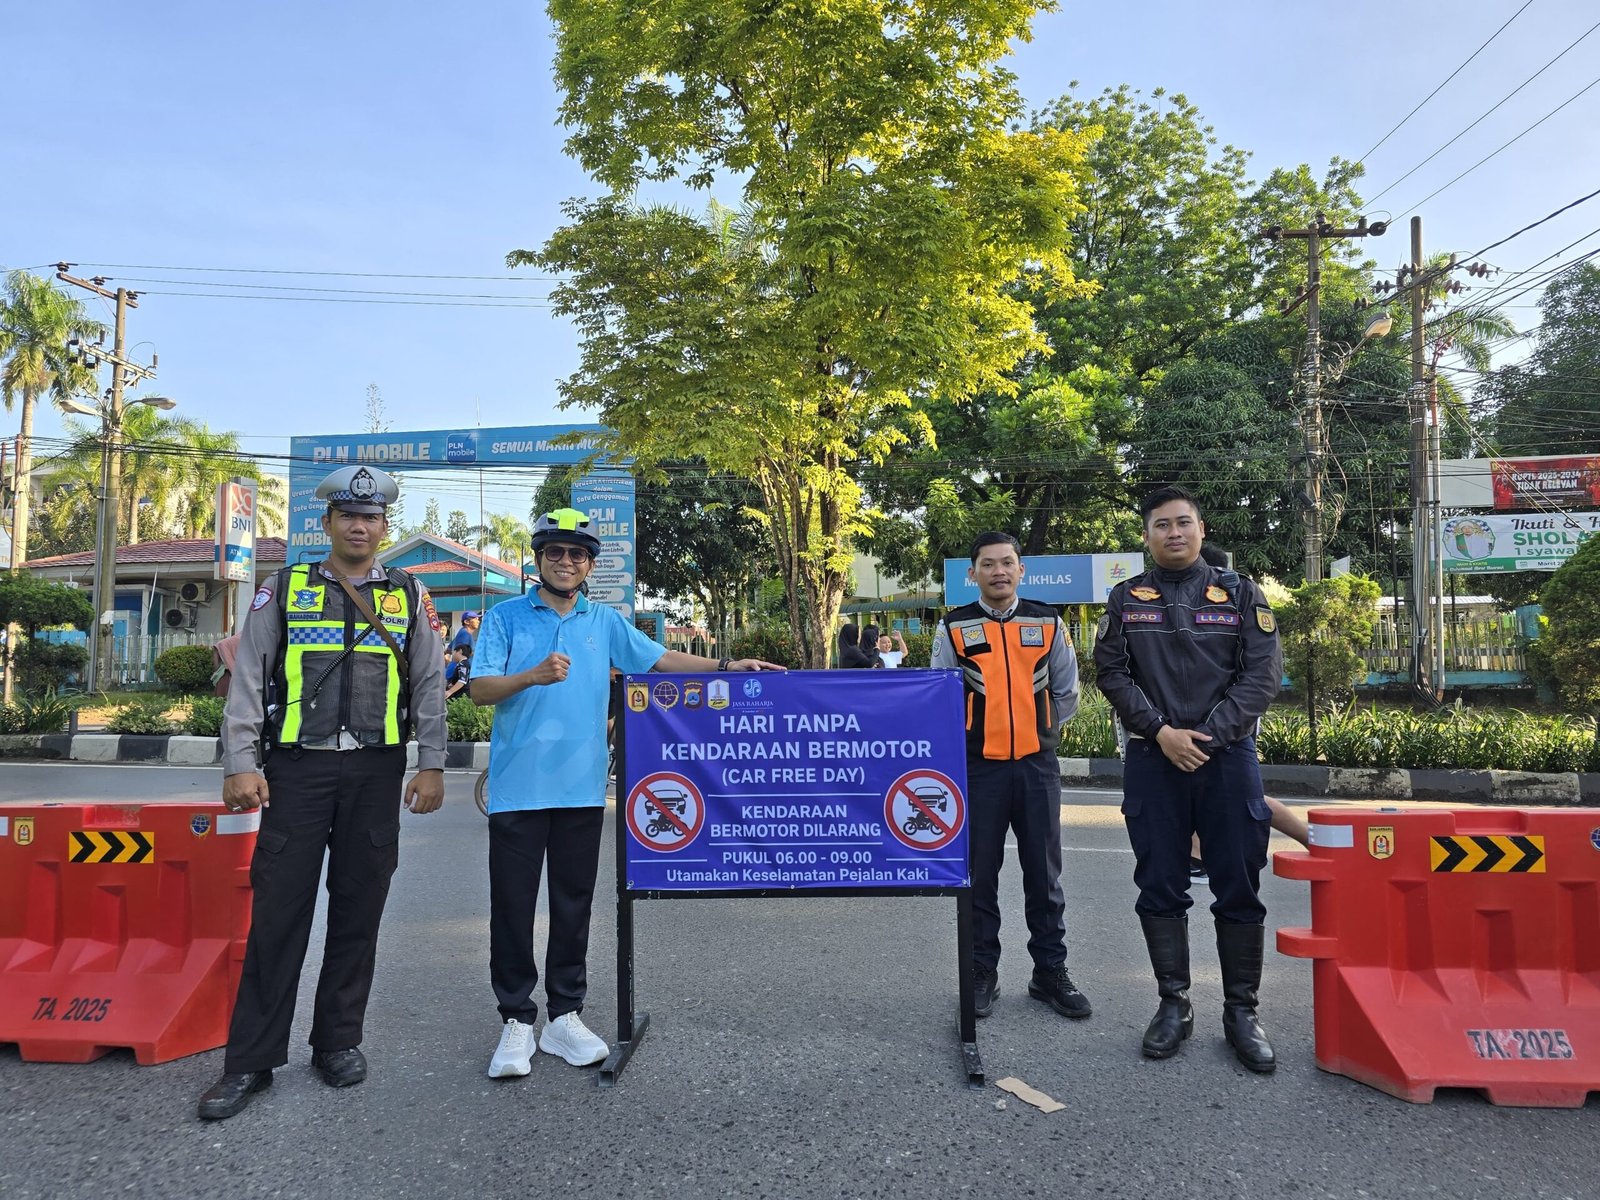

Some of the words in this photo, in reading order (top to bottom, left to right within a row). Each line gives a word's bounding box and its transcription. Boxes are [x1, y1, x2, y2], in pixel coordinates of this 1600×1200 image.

[313, 446, 350, 464] PLN
[357, 442, 431, 462] MOBILE
[448, 448, 475, 457] mobile
[491, 441, 532, 454] SEMUA
[1517, 481, 1540, 490] TIDAK
[1542, 479, 1578, 490] RELEVAN
[576, 496, 591, 504] Satu
[588, 508, 616, 522] PLN
[232, 516, 251, 532] BNI
[304, 518, 324, 531] PL
[598, 522, 629, 536] BILE
[1510, 518, 1556, 530] Ikuti
[1563, 518, 1580, 528] &
[1513, 530, 1599, 546] SHOLA
[1516, 548, 1520, 556] 1
[1028, 574, 1072, 585] IKHLAS
[720, 715, 774, 734] HARI
[782, 714, 861, 733] TANPA
[662, 742, 800, 761] KENDARAAN
[808, 740, 932, 758] BERMOTOR
[722, 768, 766, 786] (CAR
[772, 768, 817, 784] FREE
[823, 766, 865, 785] DAY)
[742, 804, 848, 819] KENDARAAN
[710, 824, 800, 838] BERMOTOR
[804, 823, 881, 838] DILARANG
[722, 852, 771, 865] PUKUL
[776, 852, 817, 864] 06.00
[830, 851, 872, 864] 09.00
[666, 869, 739, 882] Utamakan
[742, 868, 836, 882] Keselamatan
[840, 868, 893, 883] Pejalan
[897, 867, 929, 881] Kaki
[32, 998, 56, 1020] TA.
[61, 998, 112, 1022] 2025
[1466, 1030, 1511, 1058] TA.
[1512, 1030, 1573, 1059] 2025
